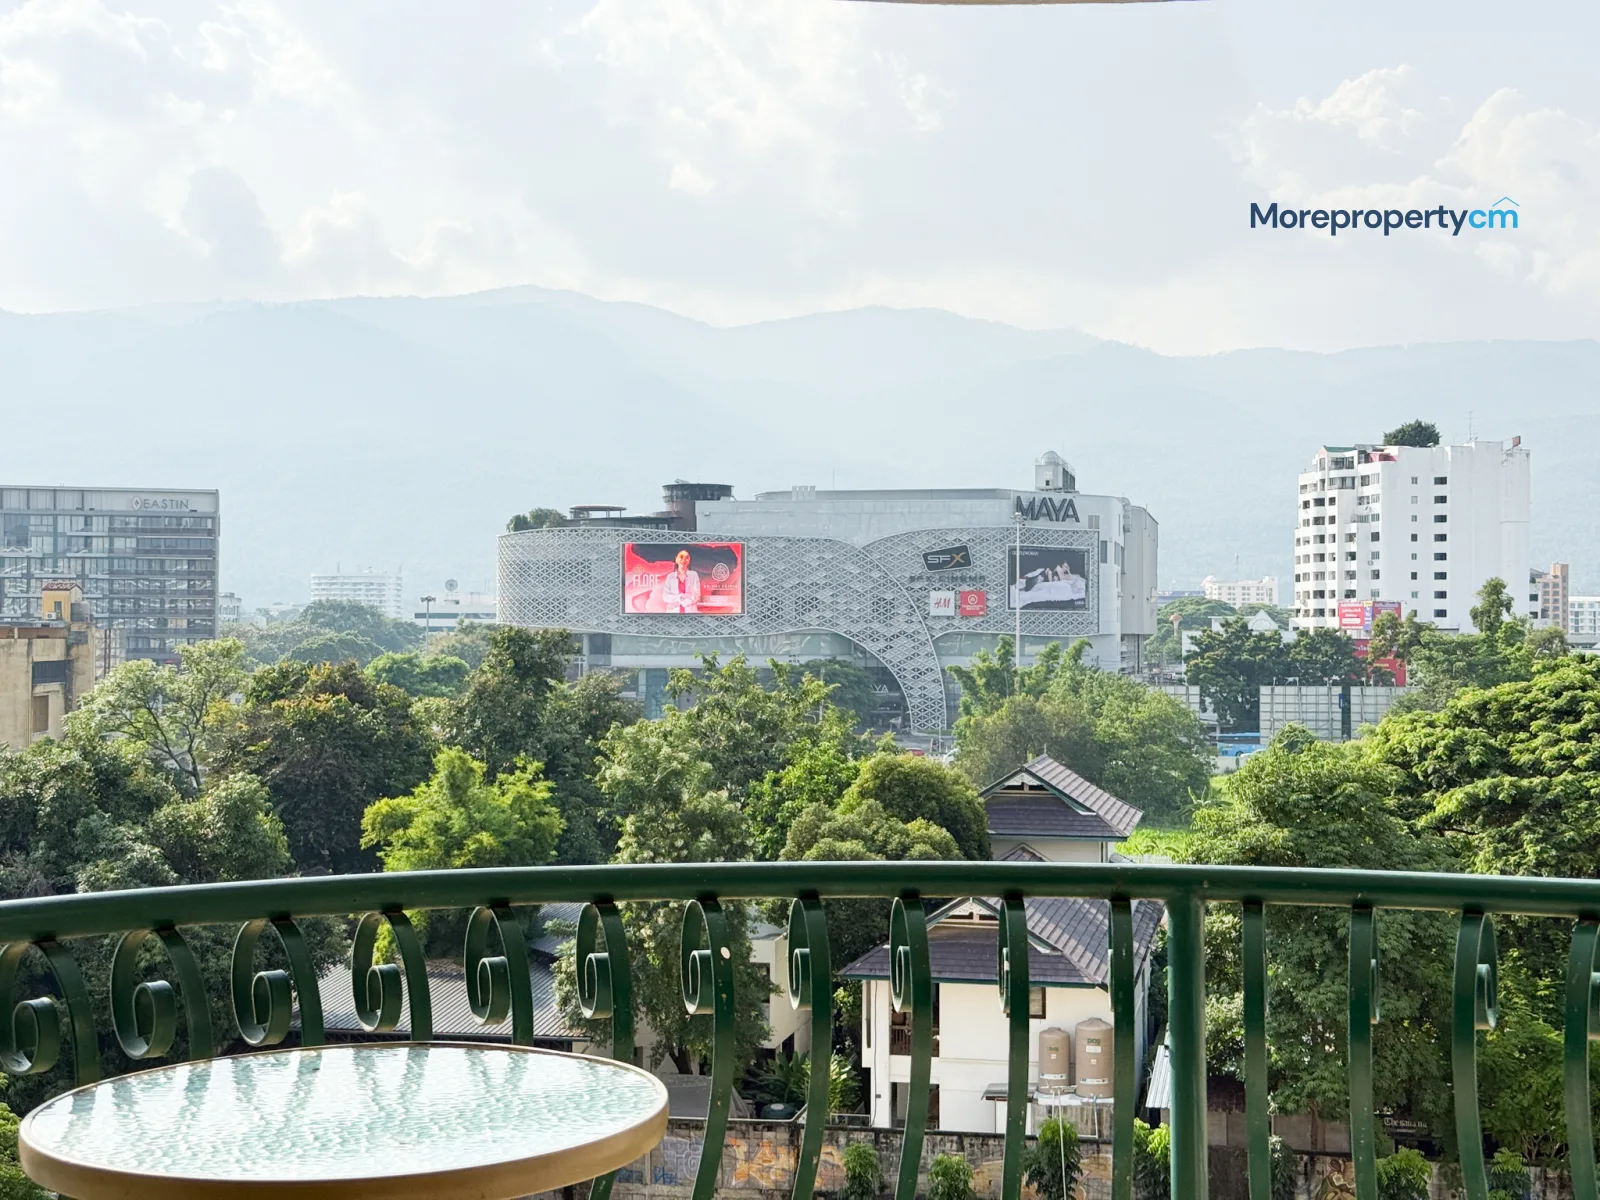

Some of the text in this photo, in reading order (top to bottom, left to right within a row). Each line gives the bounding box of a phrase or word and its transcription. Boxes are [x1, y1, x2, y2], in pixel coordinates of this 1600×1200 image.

[143, 499, 189, 509] EASTIN
[1016, 496, 1080, 523] MAYA
[927, 552, 967, 569] SFX
